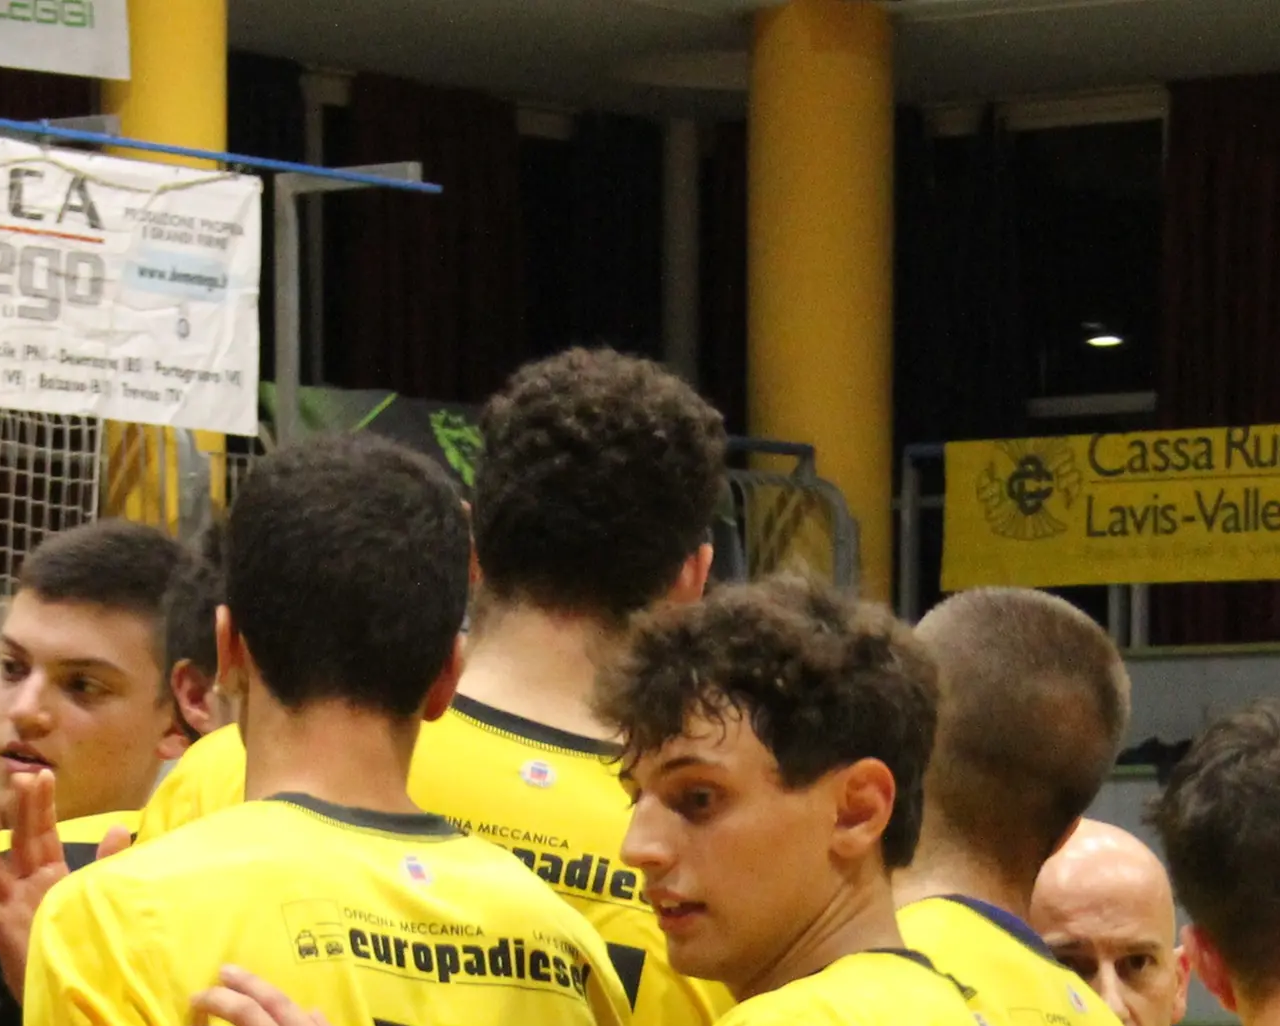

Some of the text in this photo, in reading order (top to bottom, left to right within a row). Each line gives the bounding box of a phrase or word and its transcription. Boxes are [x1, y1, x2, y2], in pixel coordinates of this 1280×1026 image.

[1087, 426, 1214, 478] Cassa
[477, 822, 570, 849] MECCANICA
[399, 920, 485, 938] MECCANICA
